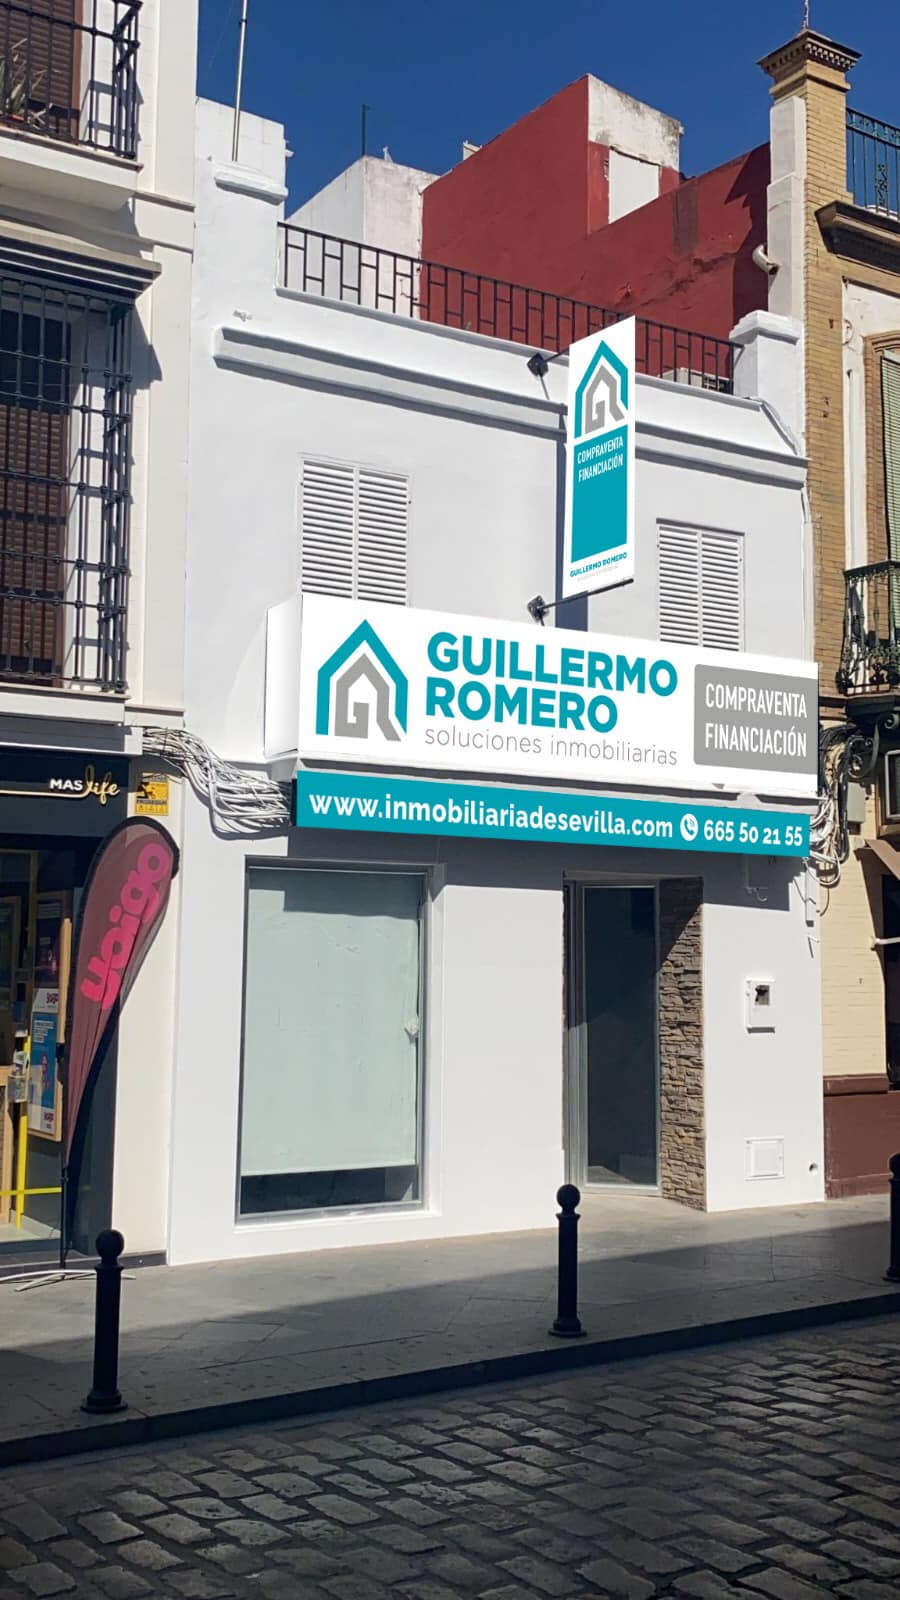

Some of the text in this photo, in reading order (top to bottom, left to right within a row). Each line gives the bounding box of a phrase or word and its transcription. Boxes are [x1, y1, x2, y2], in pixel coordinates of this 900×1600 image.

[577, 436, 624, 464] COMPRAVENTA
[578, 453, 624, 483] FINANCIACIÓN
[569, 561, 602, 577] GUILLERMO
[602, 551, 628, 567] ROMERO
[427, 631, 679, 698] GUILLERMO
[425, 676, 619, 734] ROMERO
[705, 682, 808, 720] COMPRAVENTA
[424, 724, 679, 767] soluciones inmobiliarias
[705, 722, 808, 758] FINANCIACIÓN
[49, 778, 84, 791] MAS
[309, 793, 804, 848] www.inmobiliariadesevilla.com 665 50 21 55
[80, 843, 170, 1010] yoigo
